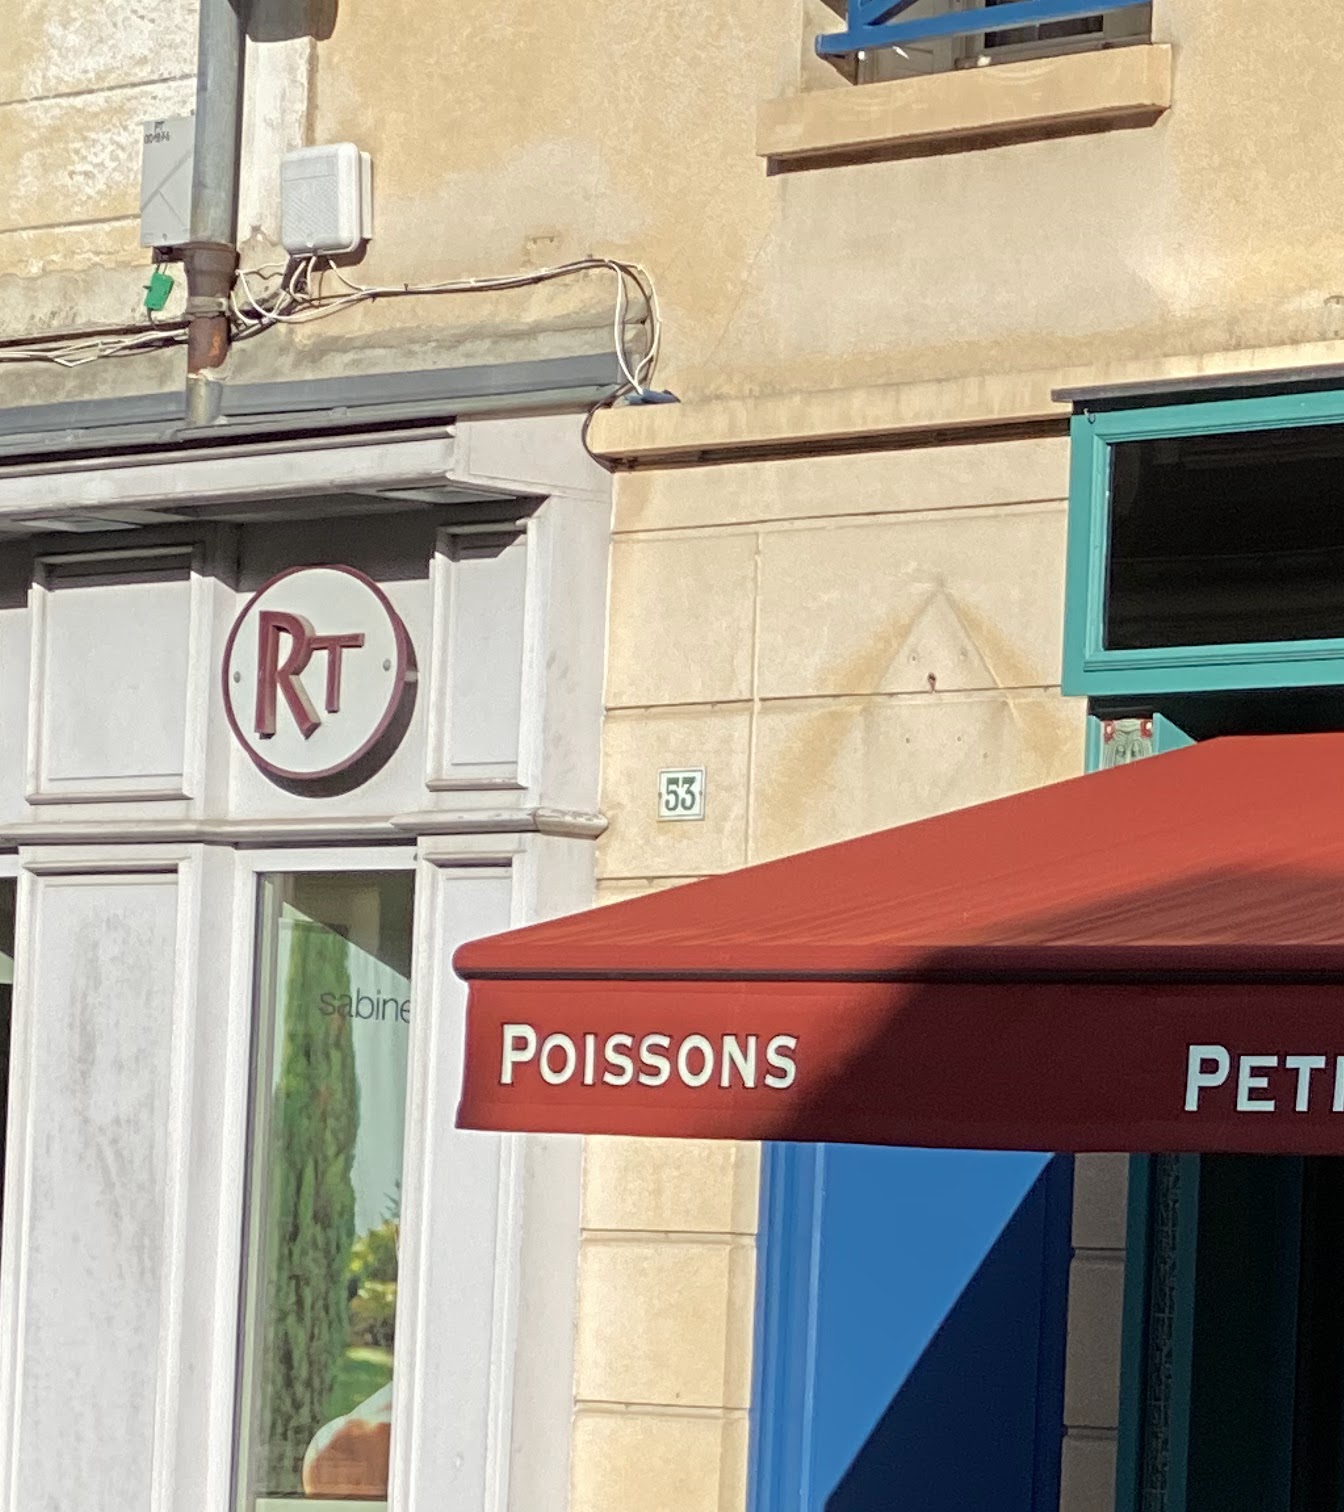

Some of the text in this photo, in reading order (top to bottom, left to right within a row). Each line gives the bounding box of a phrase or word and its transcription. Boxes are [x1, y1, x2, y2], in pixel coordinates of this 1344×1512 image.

[254, 609, 366, 741] RT
[664, 776, 697, 811] 53
[318, 987, 411, 1024] sabine
[499, 1022, 799, 1090] POISSONS
